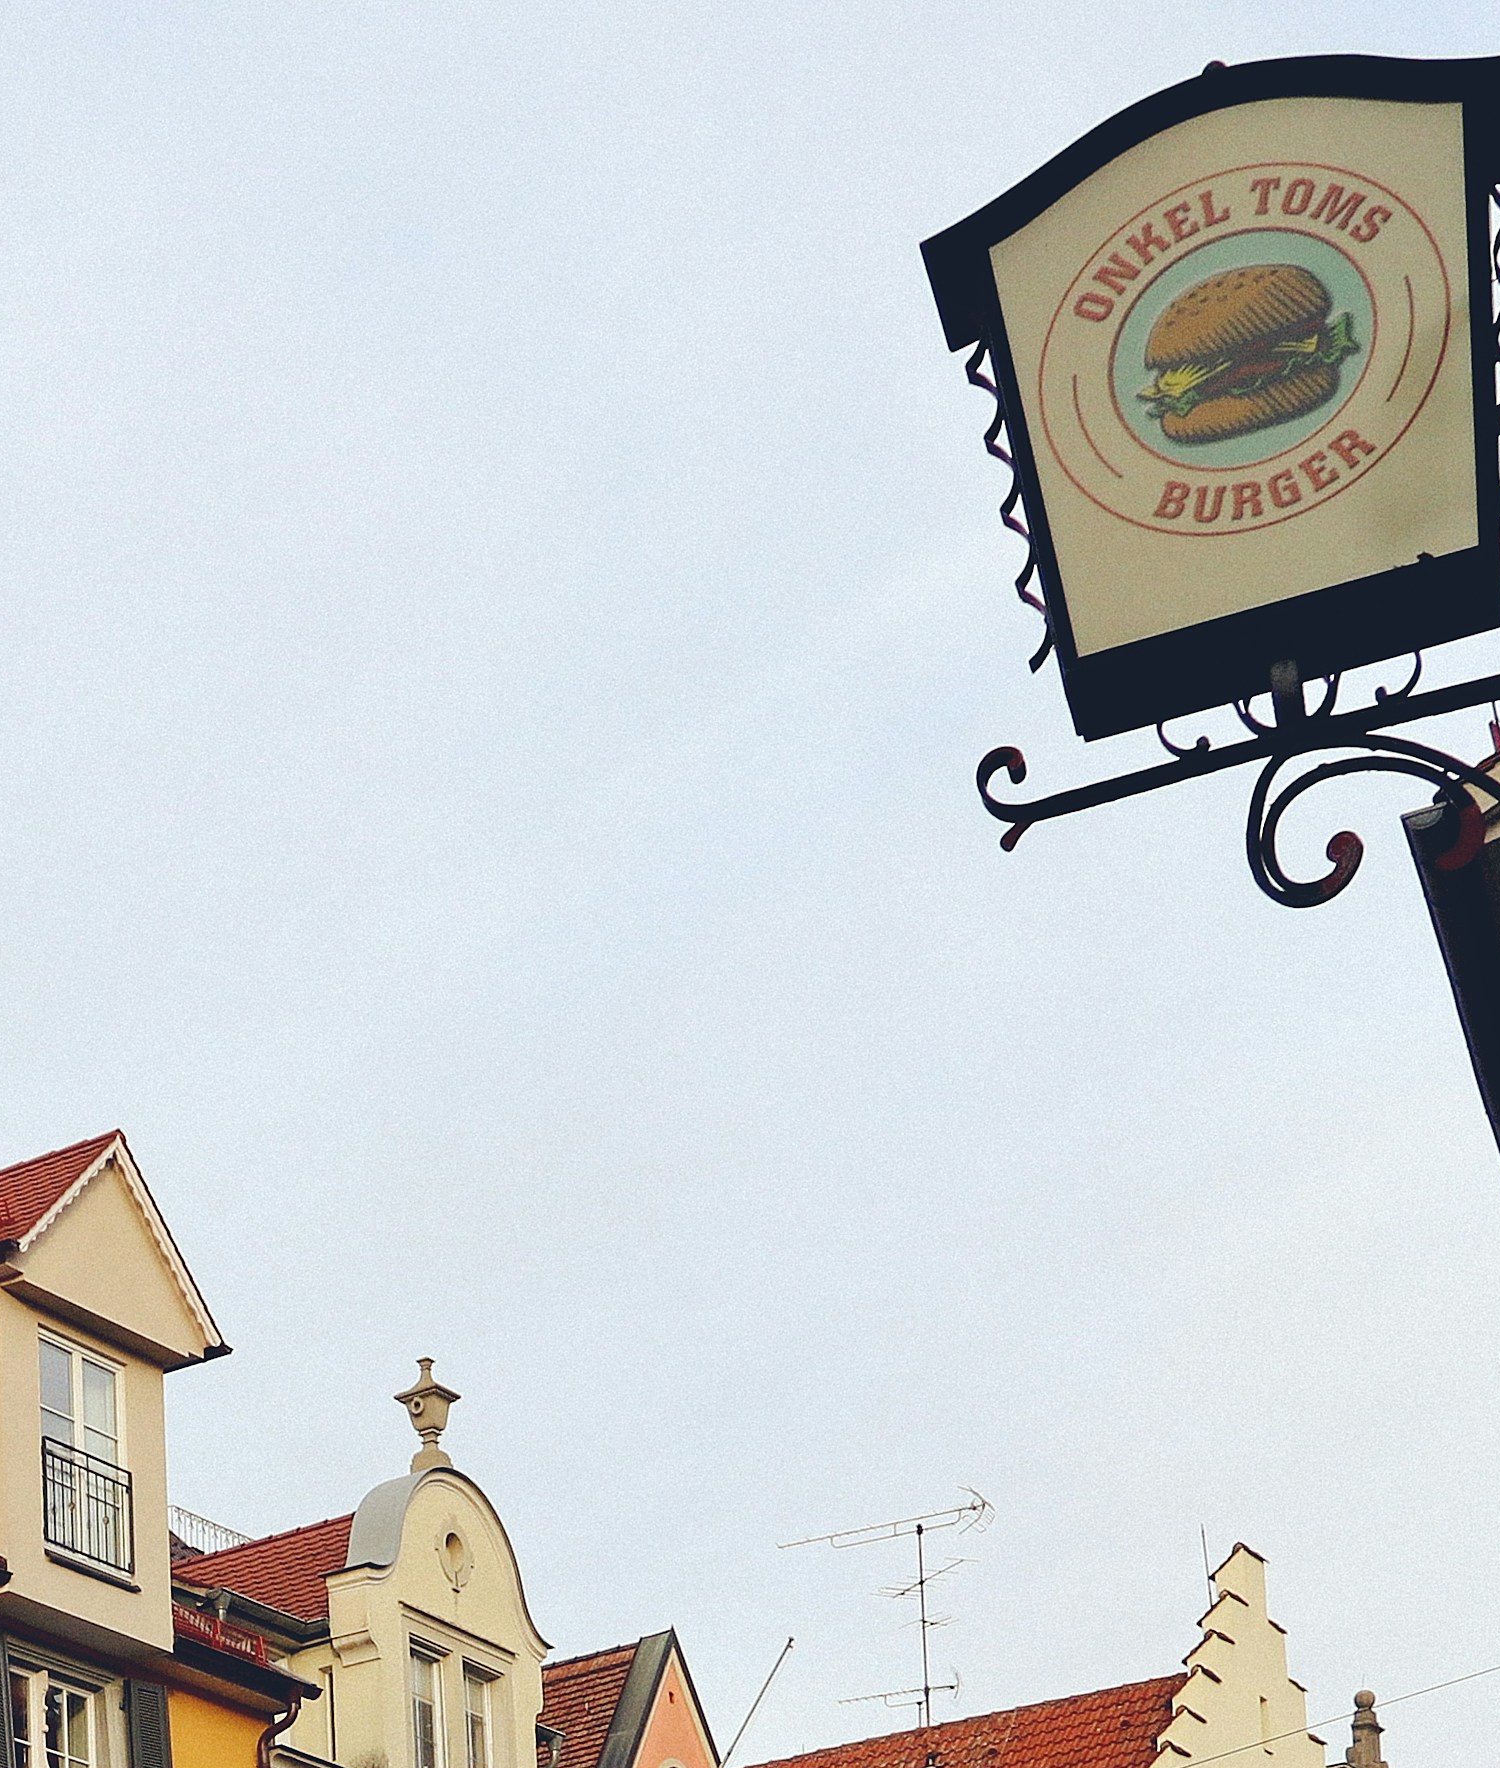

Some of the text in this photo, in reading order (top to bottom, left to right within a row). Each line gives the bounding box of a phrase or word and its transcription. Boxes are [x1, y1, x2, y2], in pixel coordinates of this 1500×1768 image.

[1073, 177, 1393, 323] ONKEL TOMS
[1153, 429, 1377, 524] BURGER
